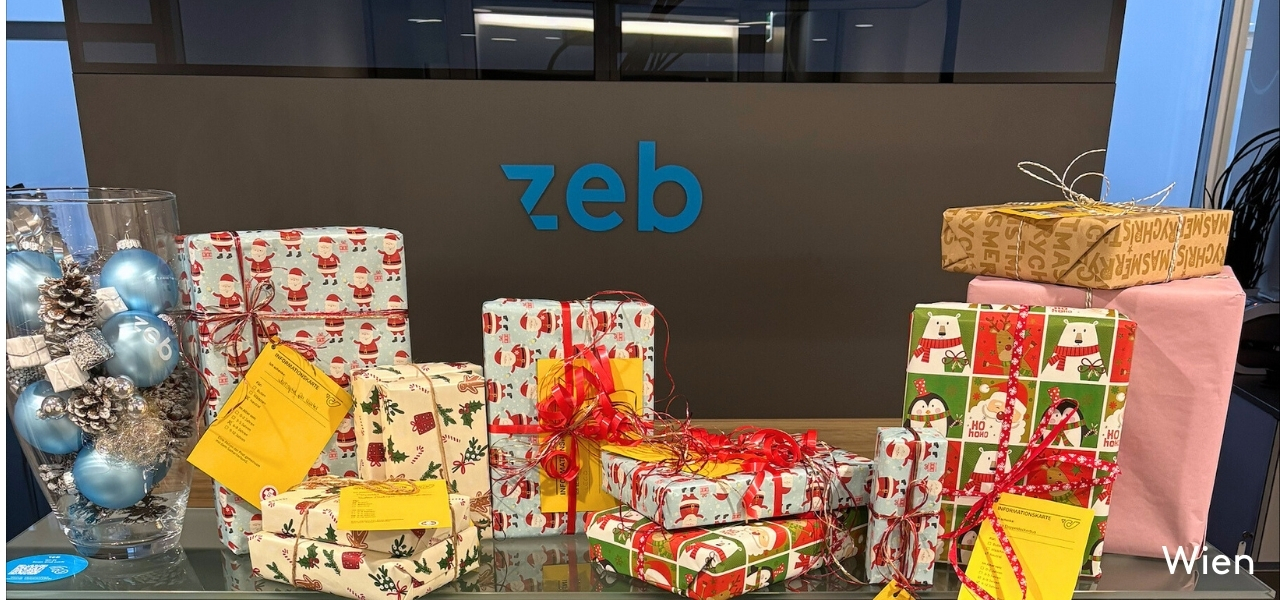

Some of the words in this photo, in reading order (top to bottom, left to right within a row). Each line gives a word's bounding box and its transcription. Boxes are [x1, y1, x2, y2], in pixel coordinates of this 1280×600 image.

[500, 140, 703, 233] zeb
[134, 315, 172, 361] zeb
[274, 352, 320, 390] INFORMATIONSKARTE
[971, 420, 986, 430] HO
[997, 506, 1052, 522] INFORMATIONSKARTE
